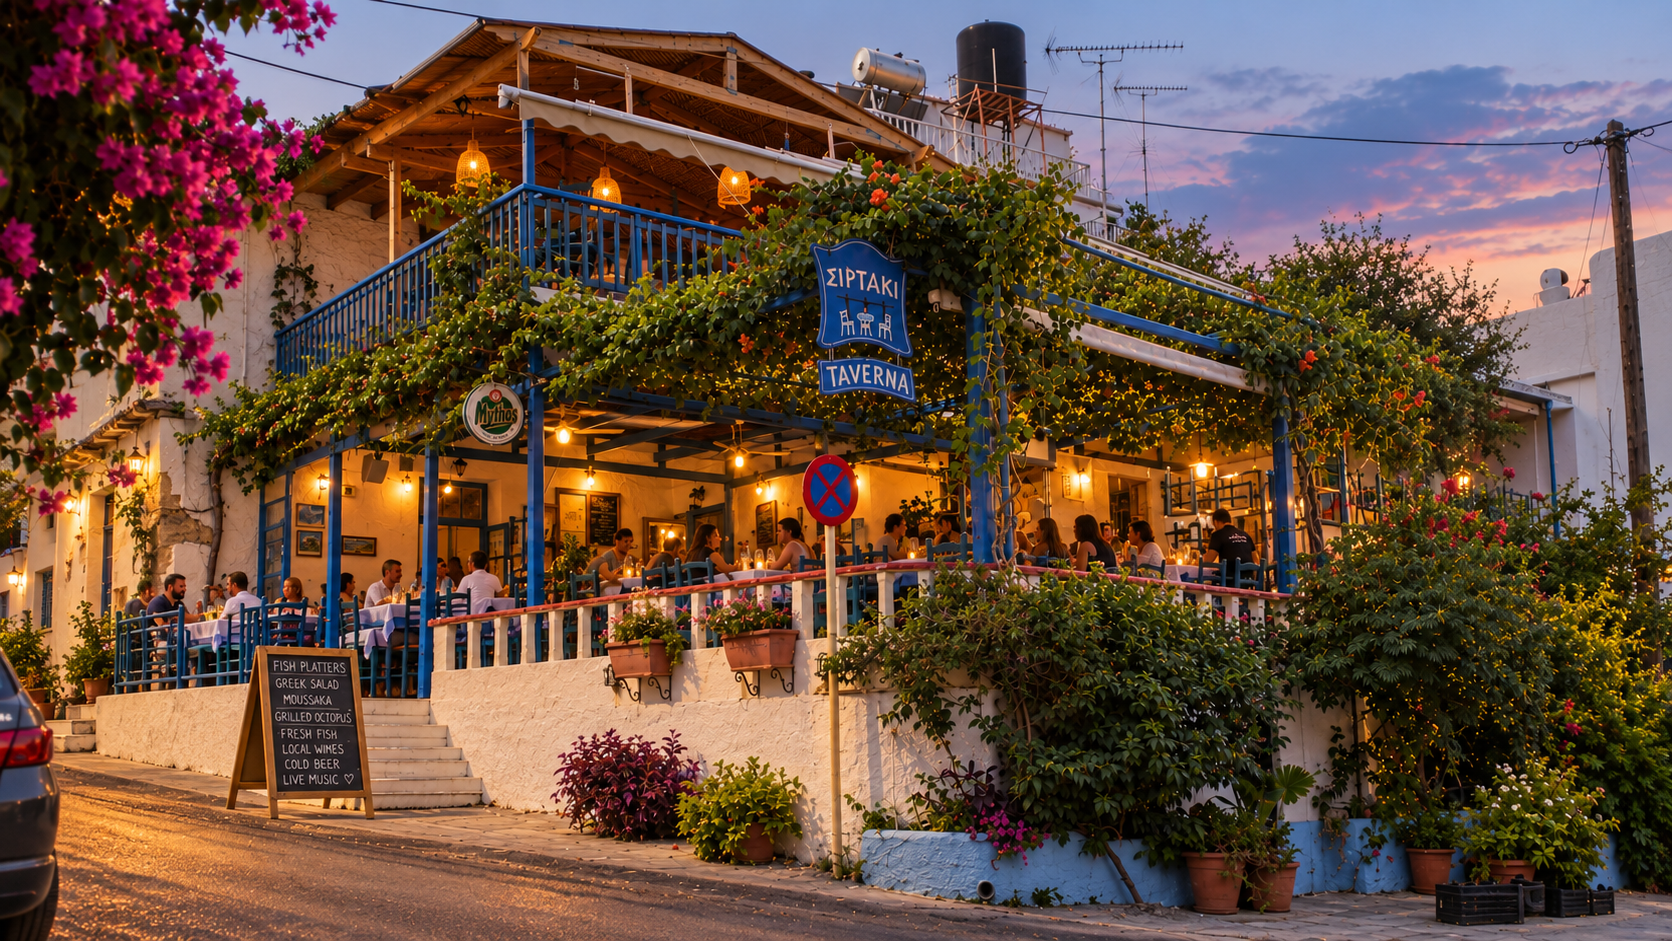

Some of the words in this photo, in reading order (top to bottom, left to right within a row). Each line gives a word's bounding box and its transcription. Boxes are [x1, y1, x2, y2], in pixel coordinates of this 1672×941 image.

[826, 267, 898, 300] ΣΙΡΤΑΚΙ
[826, 364, 909, 395] TAVERNA
[474, 400, 518, 426] Mythos
[273, 660, 296, 672] FISH
[300, 661, 346, 673] PLATTERS
[275, 678, 307, 689] GREEK
[310, 679, 340, 690] SALAD
[283, 694, 332, 706] MOUSSAKA
[274, 711, 312, 722] GRILLED
[314, 712, 352, 723] OCTOPUS
[280, 728, 312, 740] FRESH
[316, 728, 338, 740] FISH
[282, 743, 312, 755] LOCAL
[313, 743, 345, 755] WINES
[284, 758, 310, 770] COLD
[313, 758, 340, 770] BEER
[282, 774, 305, 785] LIVE
[308, 774, 340, 785] MUSIC
